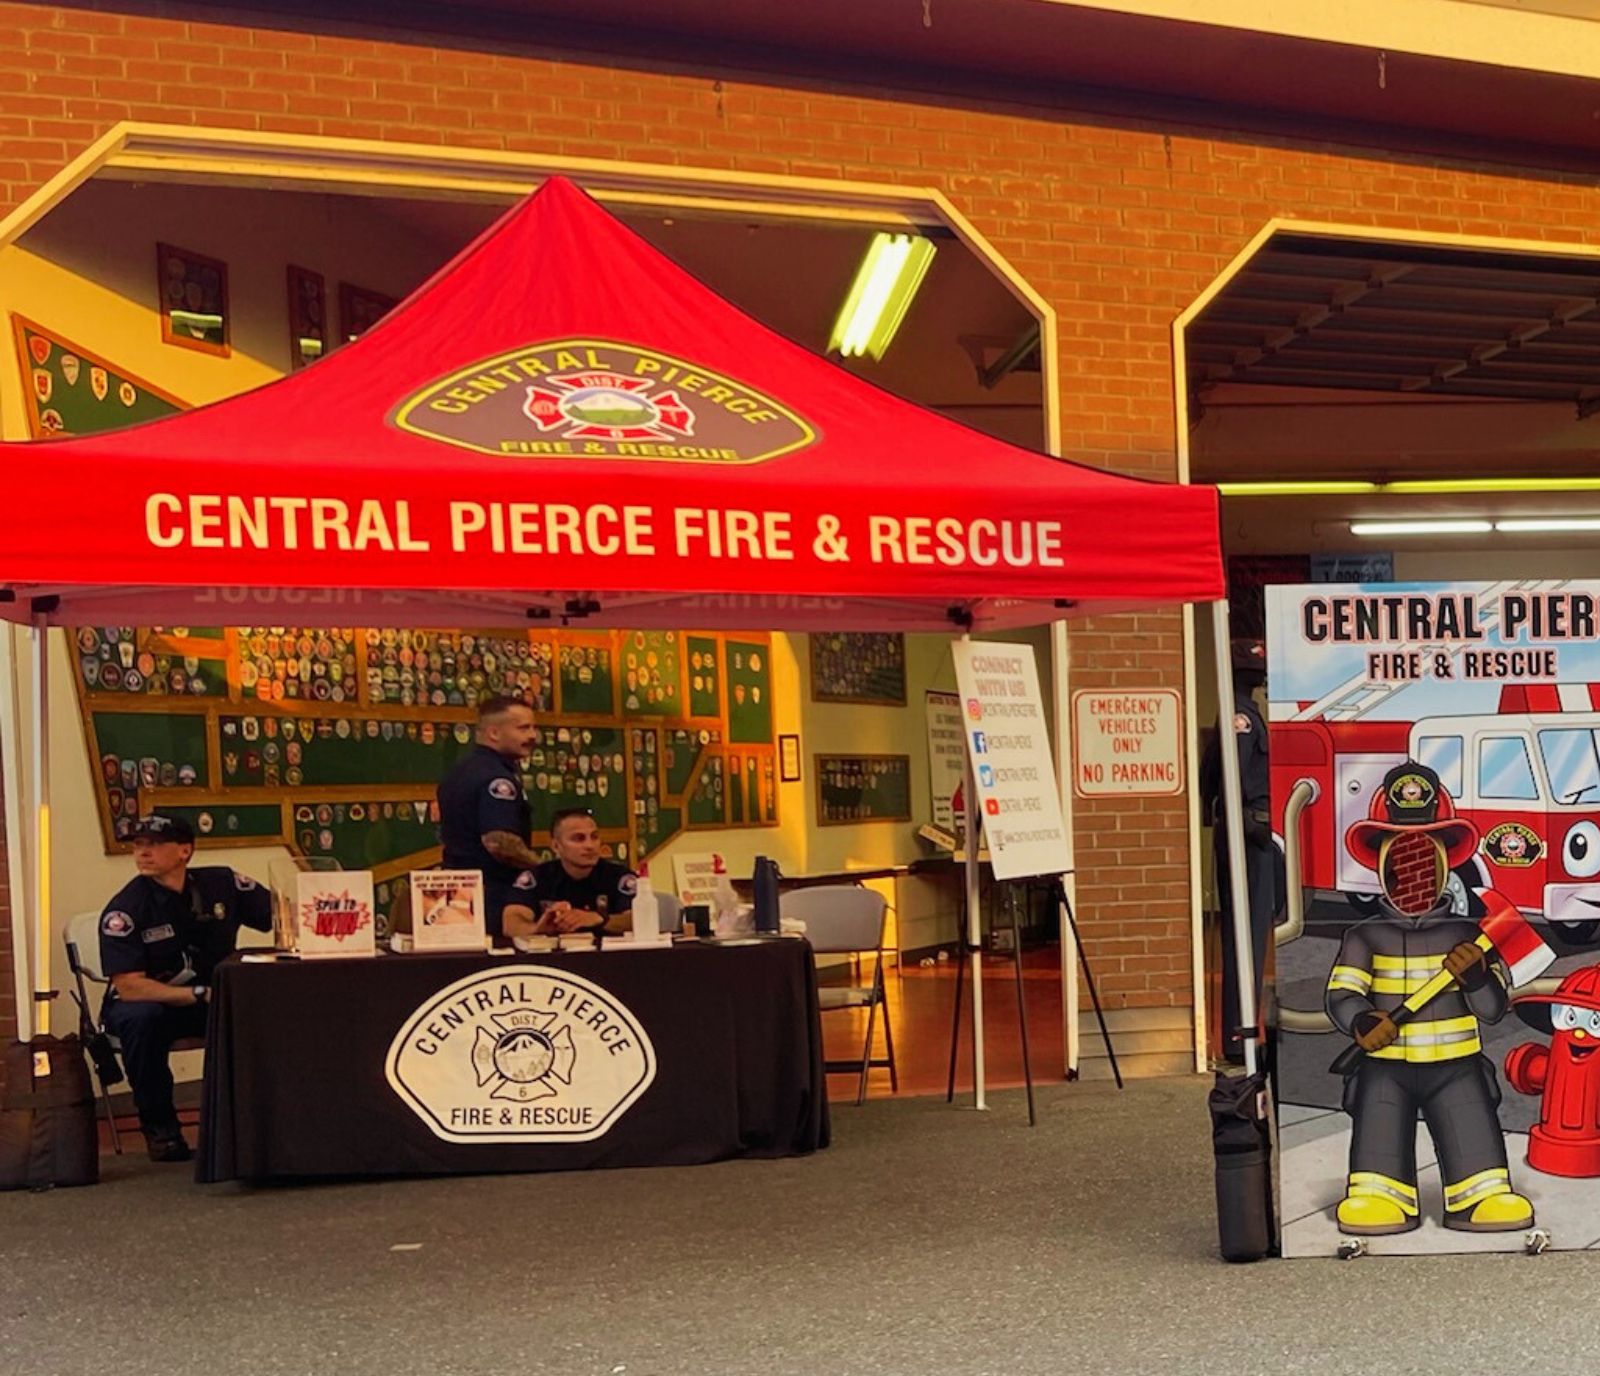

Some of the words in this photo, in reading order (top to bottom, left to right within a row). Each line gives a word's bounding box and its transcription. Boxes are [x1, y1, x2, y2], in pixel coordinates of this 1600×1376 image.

[430, 349, 611, 415] CENTRAL
[635, 357, 778, 425] PIERCE
[499, 441, 573, 454] FIRE
[584, 442, 607, 455] &
[625, 443, 739, 461] RESCUE
[145, 493, 430, 551] CENTRAL
[450, 501, 655, 556] PIERCE
[674, 507, 794, 560] FIRE
[813, 514, 849, 562] &
[869, 516, 1064, 568] RESCUE
[1303, 596, 1484, 642] CENTRAL
[1369, 652, 1421, 680] FIRE
[1434, 652, 1453, 678] &
[1464, 650, 1557, 679] RESCUE
[1089, 698, 1162, 715] EMERGENCY
[1098, 718, 1157, 734] VEHICLES
[1112, 737, 1142, 754] ONLY
[1083, 764, 1104, 783] NO
[1112, 762, 1175, 782] PARKING
[315, 899, 341, 912] SPIN
[416, 982, 532, 1056] CENTRAL
[547, 986, 632, 1057] PIERCE
[519, 1087, 527, 1098] 6
[451, 1108, 493, 1126] FIRE
[499, 1108, 513, 1126] &
[520, 1107, 593, 1125] RESCUE
